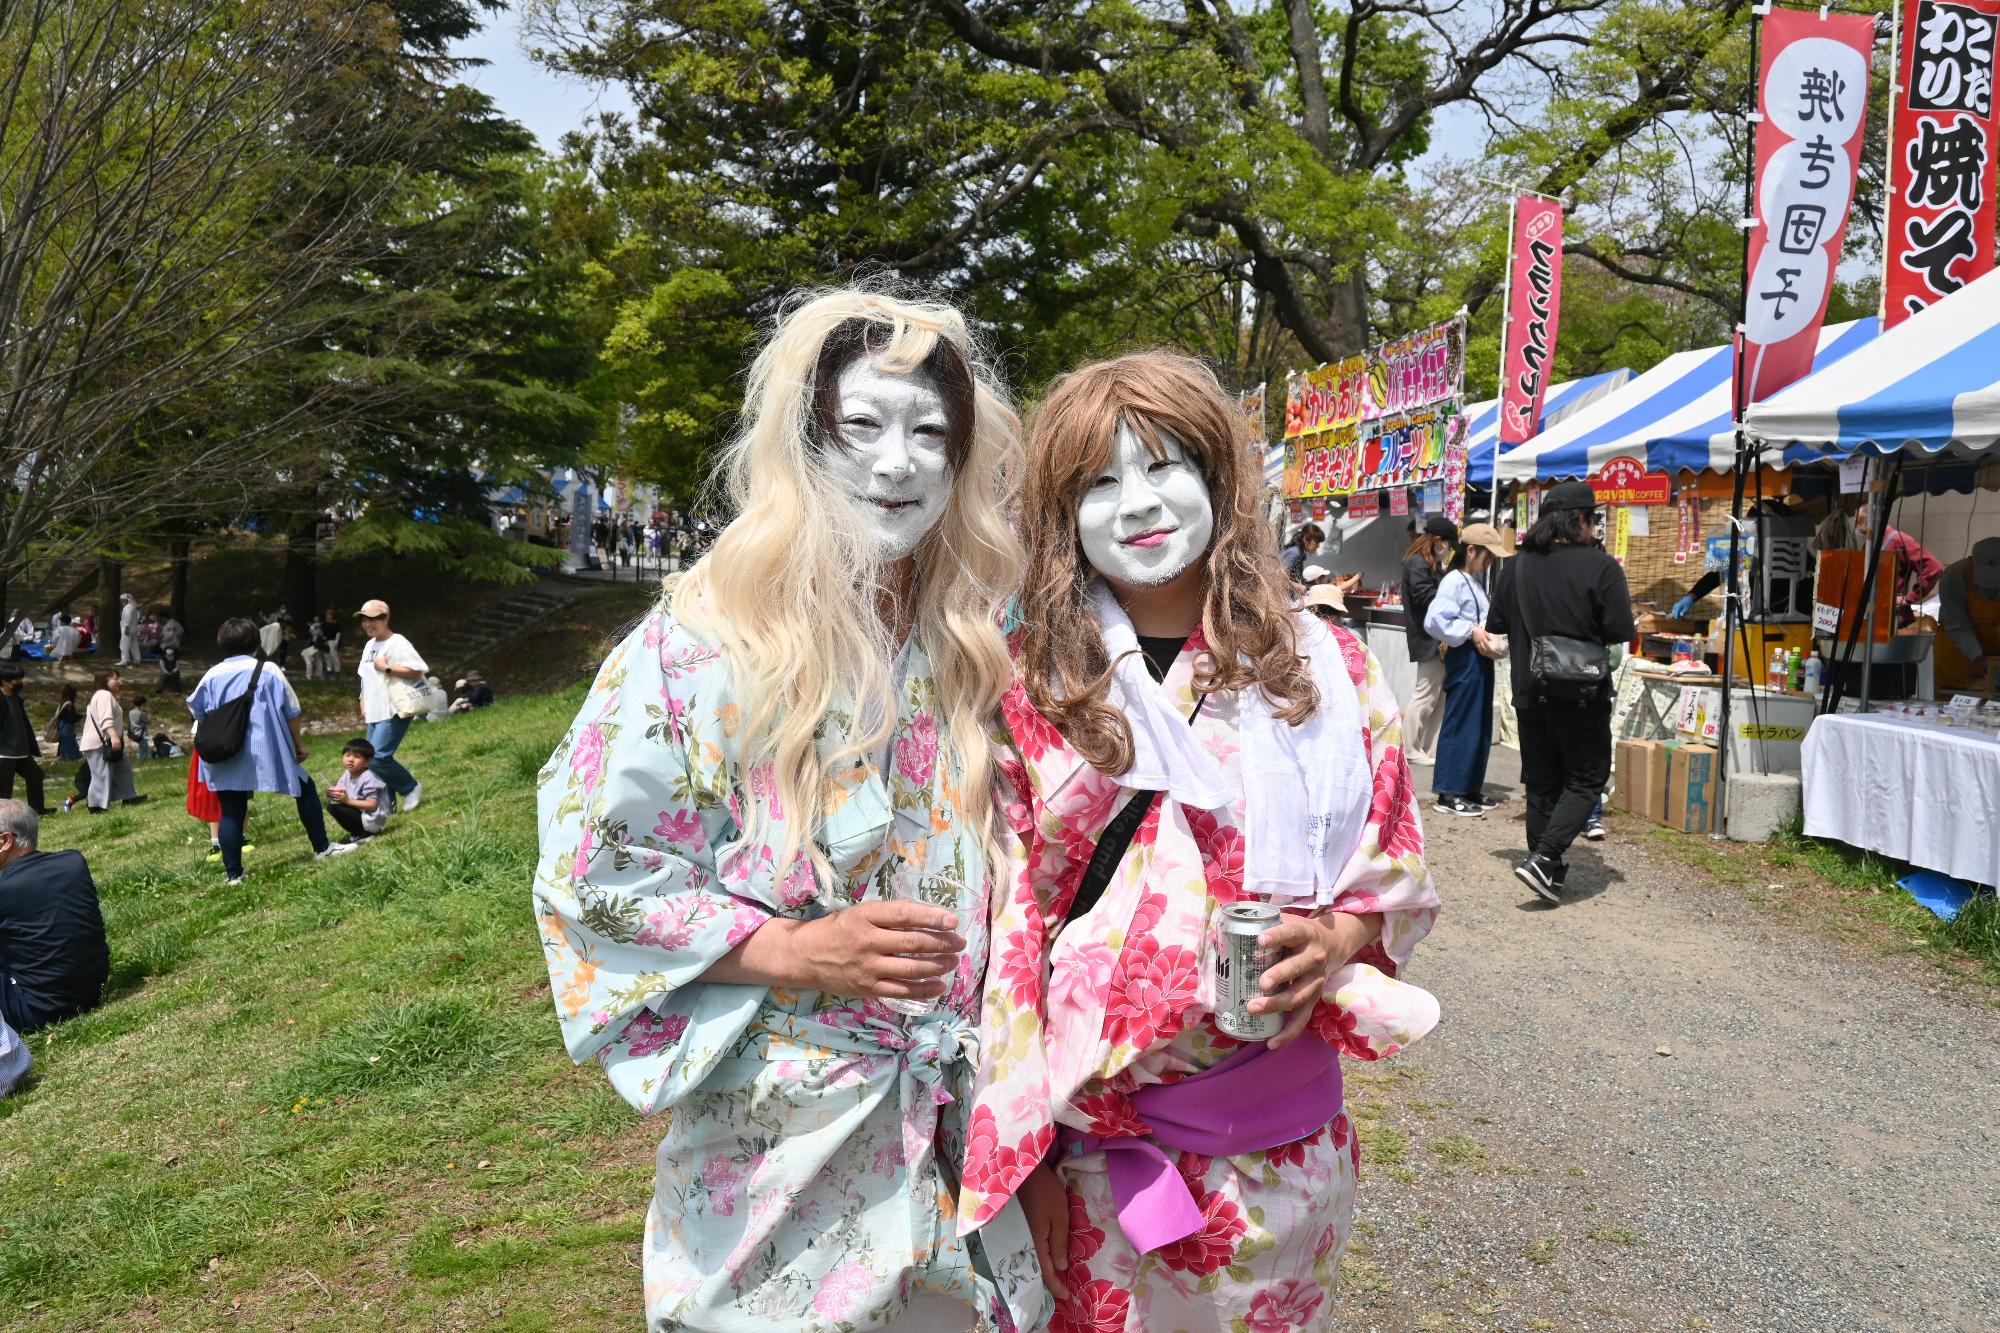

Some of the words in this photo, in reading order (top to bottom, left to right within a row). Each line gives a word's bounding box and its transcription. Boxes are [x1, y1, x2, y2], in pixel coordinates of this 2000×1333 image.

[1918, 4, 1966, 107] わり
[1963, 16, 1993, 114] こだ
[1904, 116, 1986, 316] 焼そ
[1308, 368, 1364, 430] からあげ
[1386, 344, 1448, 410] バナナチョコ
[1301, 439, 1358, 494] やきそば
[1595, 489, 1635, 501] RAVAN
[1635, 490, 1665, 500] COFFEE
[1743, 726, 1802, 740] キャラバン
